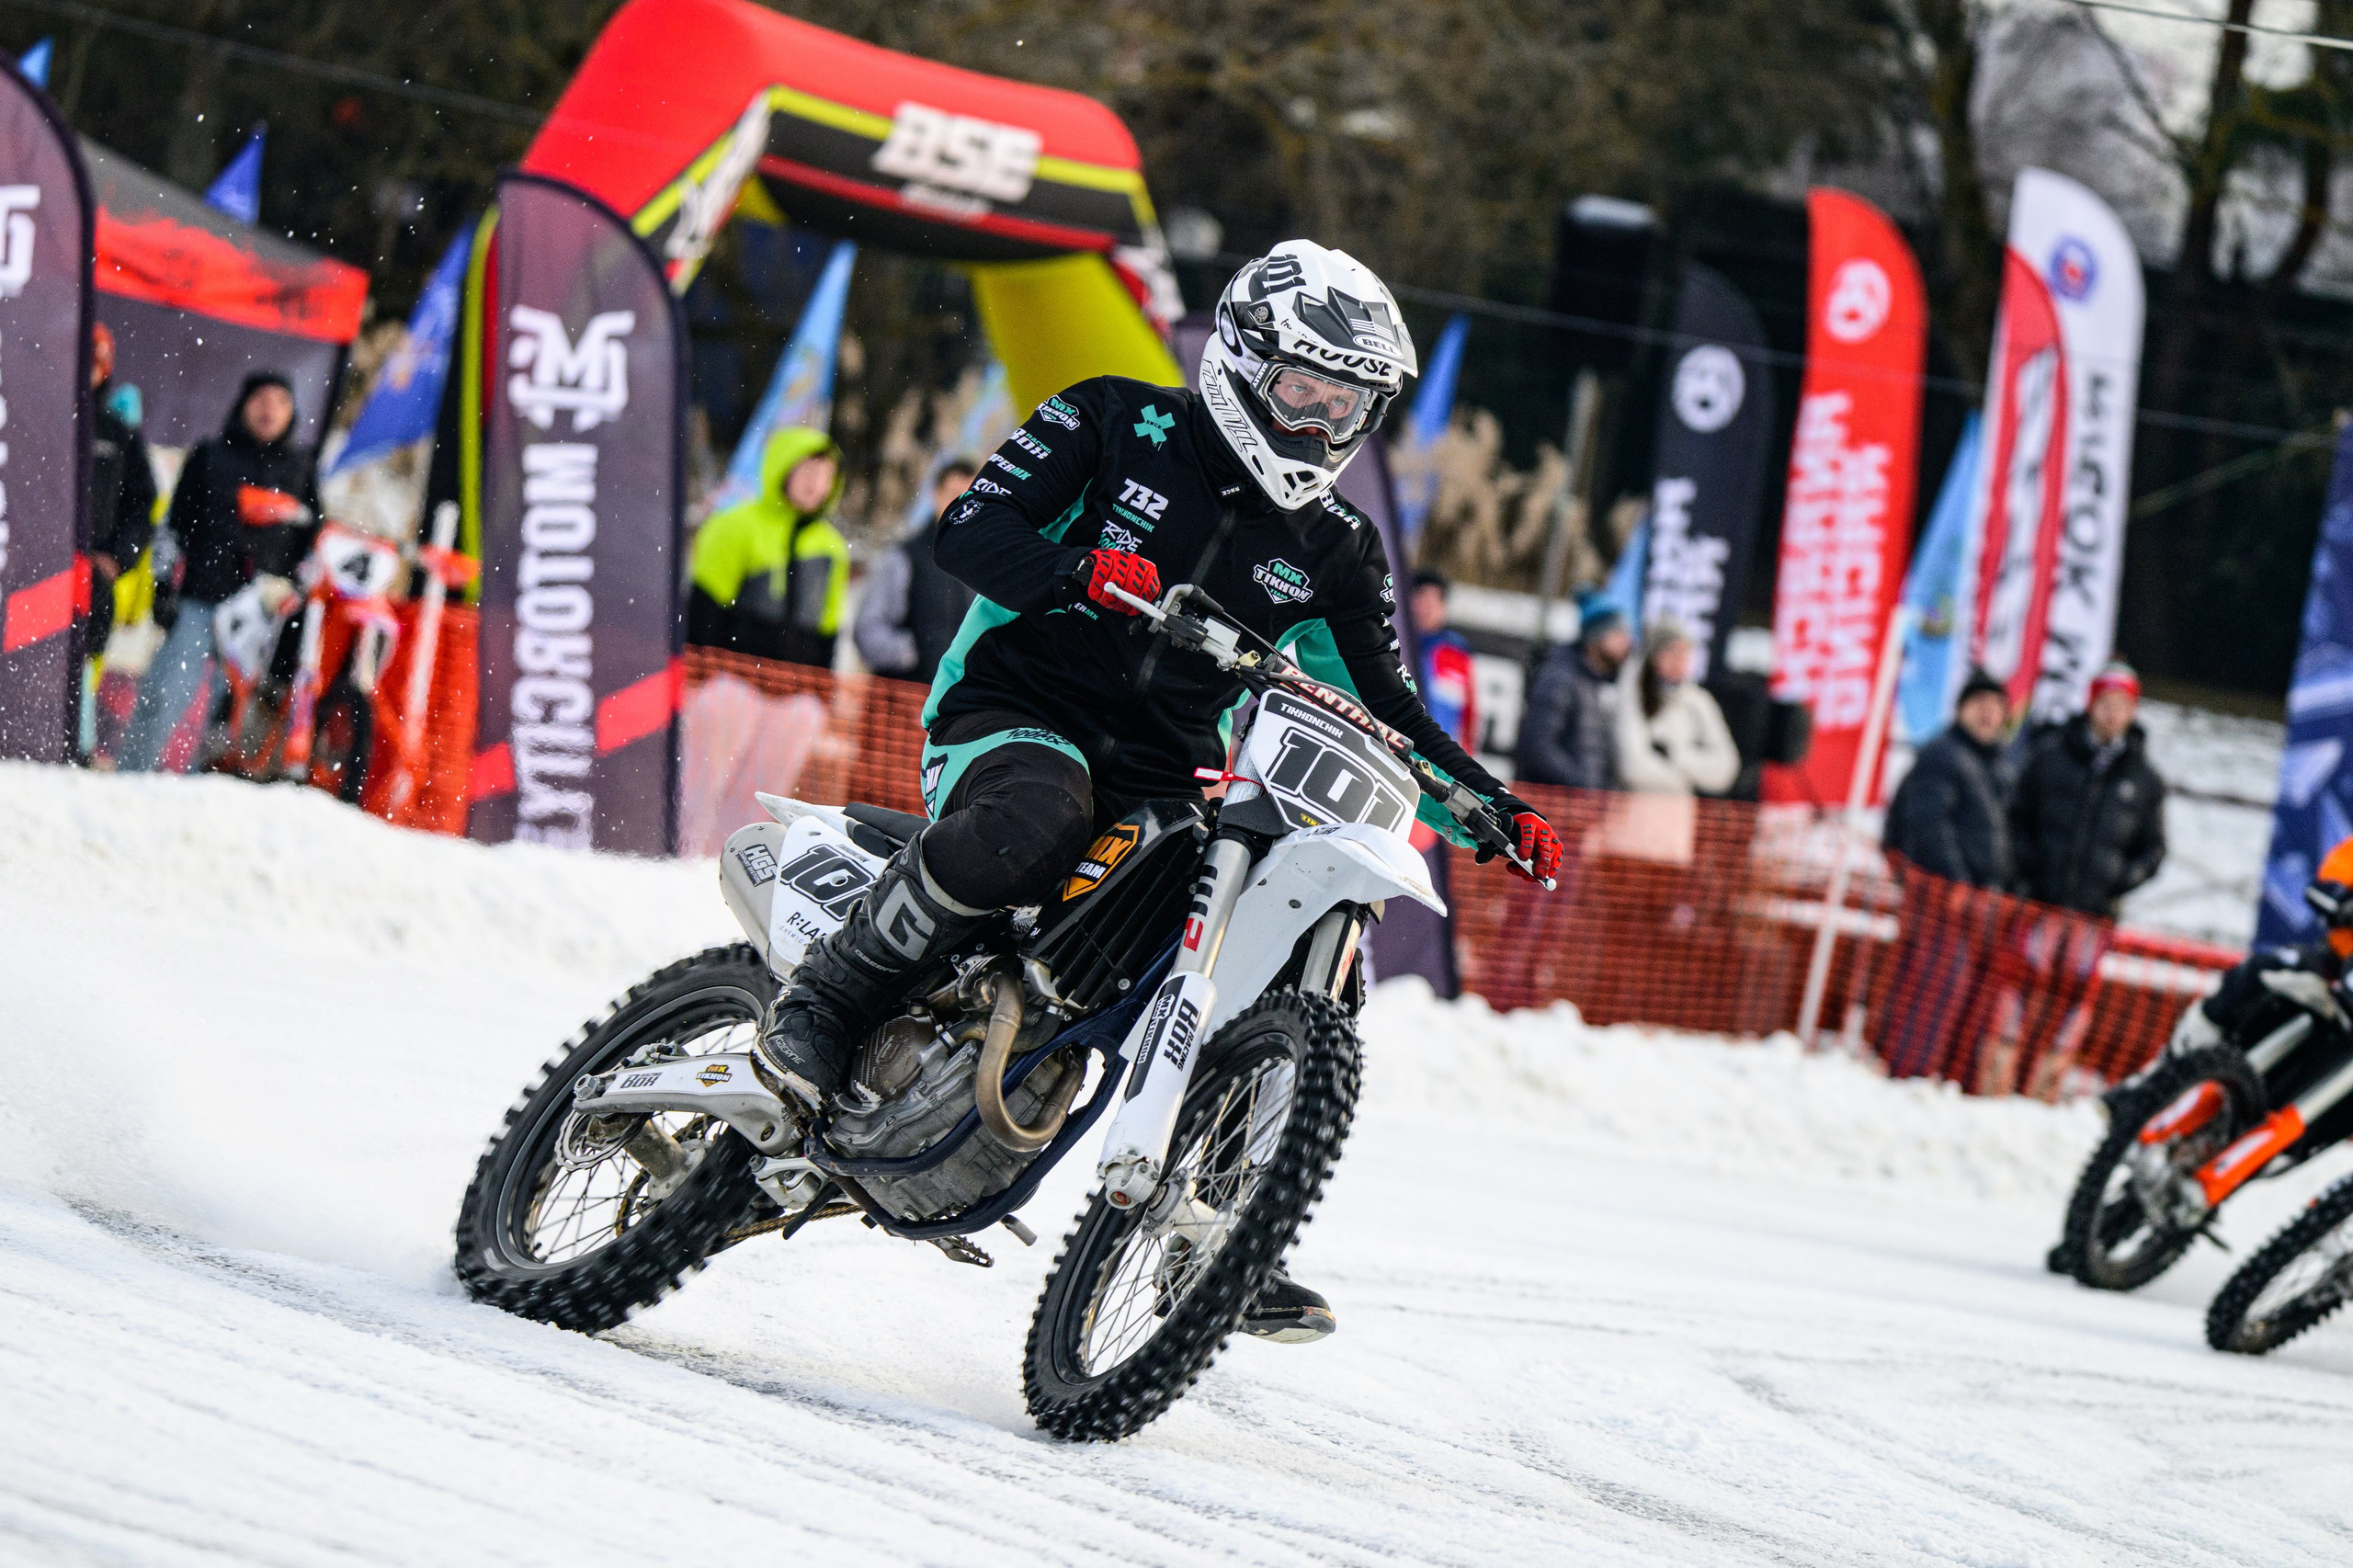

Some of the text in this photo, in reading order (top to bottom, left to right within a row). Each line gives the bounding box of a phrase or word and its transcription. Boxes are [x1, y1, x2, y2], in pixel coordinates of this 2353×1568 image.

[871, 102, 1042, 203] BSE
[1361, 338, 1394, 354] BELL
[1252, 363, 1268, 388] OAKLEY
[1051, 397, 1075, 415] MX
[1025, 433, 1052, 454] RACING
[1118, 478, 1169, 521] 732
[1112, 503, 1155, 533] TIKHONCHIK
[1256, 567, 1311, 600] TIKHON
[1272, 562, 1303, 586] MX
[1269, 588, 1289, 600] TEAM
[1279, 664, 1406, 750] RENTHAL
[1280, 702, 1345, 739] TIKHONCHIK
[1267, 726, 1406, 834] 101
[745, 845, 778, 881] HGS
[1074, 862, 1107, 880] TEAM
[876, 880, 936, 960] G
[1137, 1019, 1158, 1064] TIKHON
[1163, 997, 1199, 1067] BOX
[776, 1038, 806, 1064] GAERNE
[1177, 1030, 1195, 1072] RACING
[620, 1074, 660, 1089] BOX
[696, 1072, 732, 1082] TIKHON
[708, 1064, 728, 1074] MX
